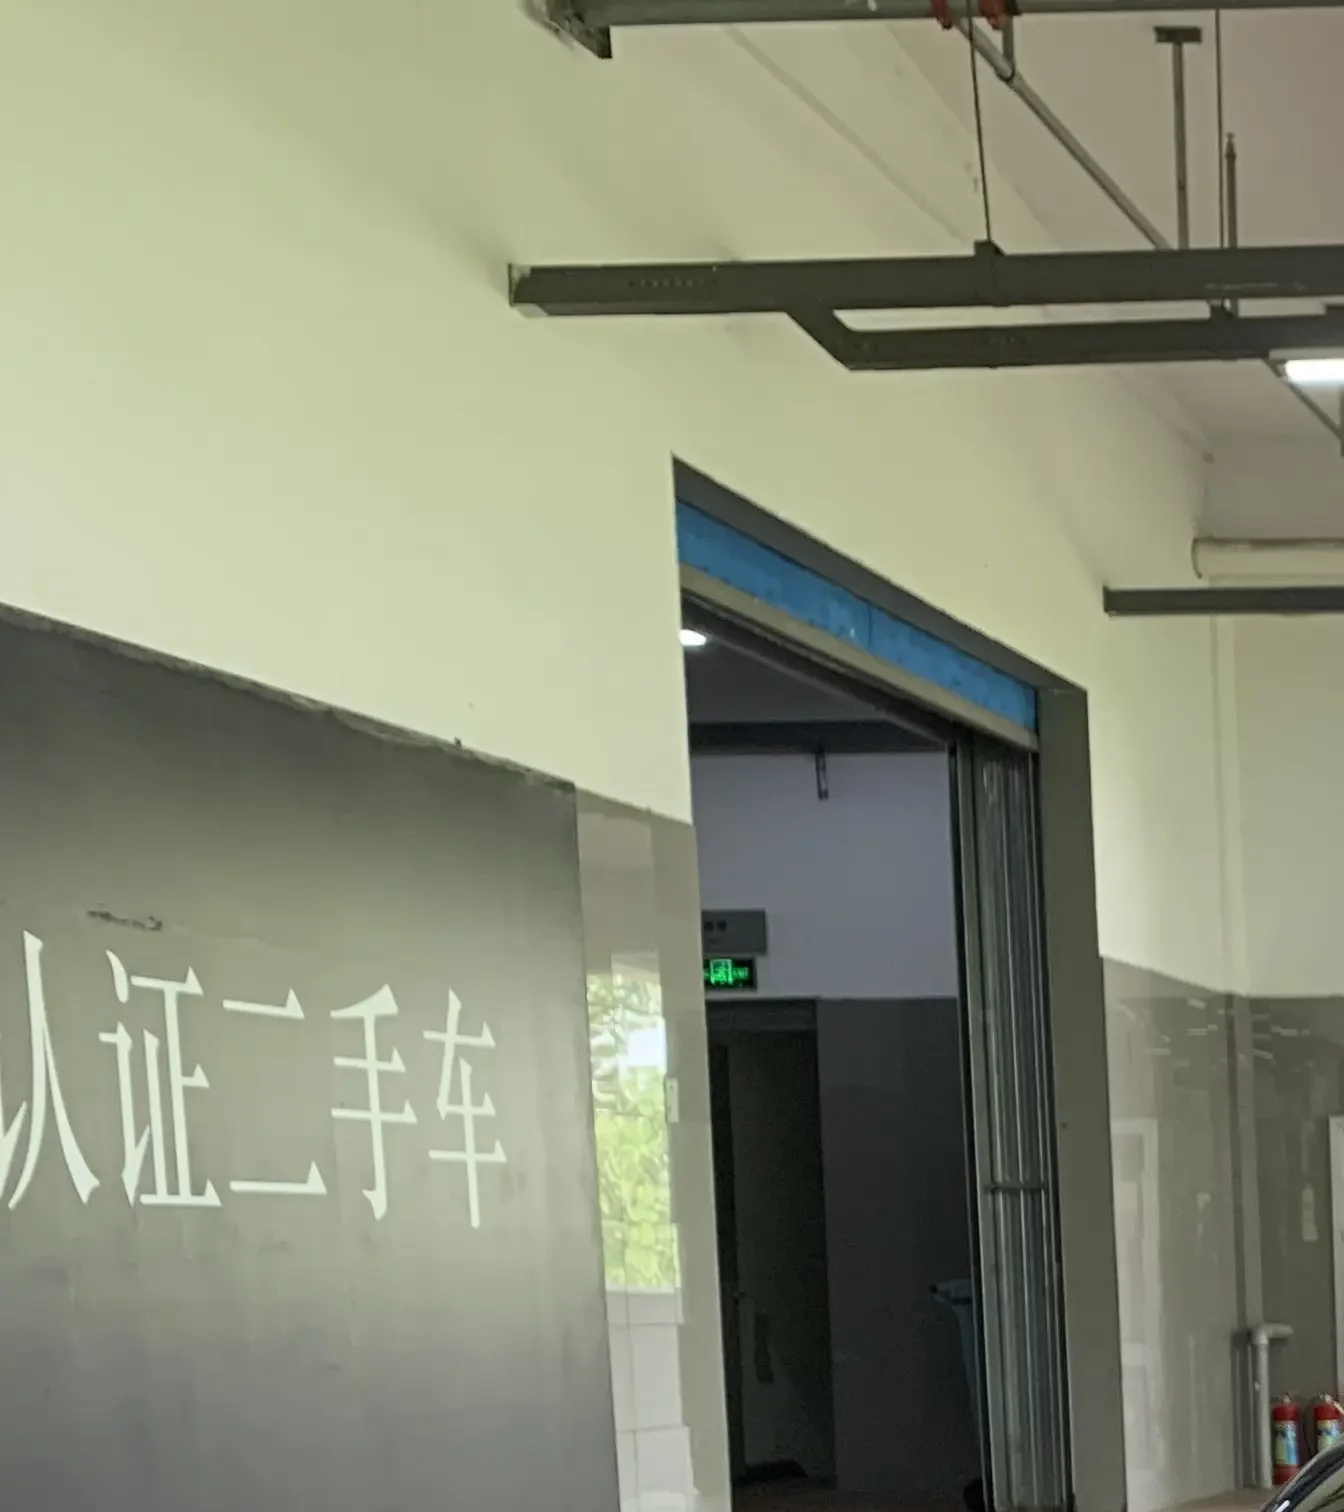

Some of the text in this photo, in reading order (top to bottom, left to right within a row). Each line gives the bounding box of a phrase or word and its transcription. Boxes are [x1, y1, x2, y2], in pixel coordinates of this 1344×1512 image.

[0, 930, 508, 1229] 认证二手车
